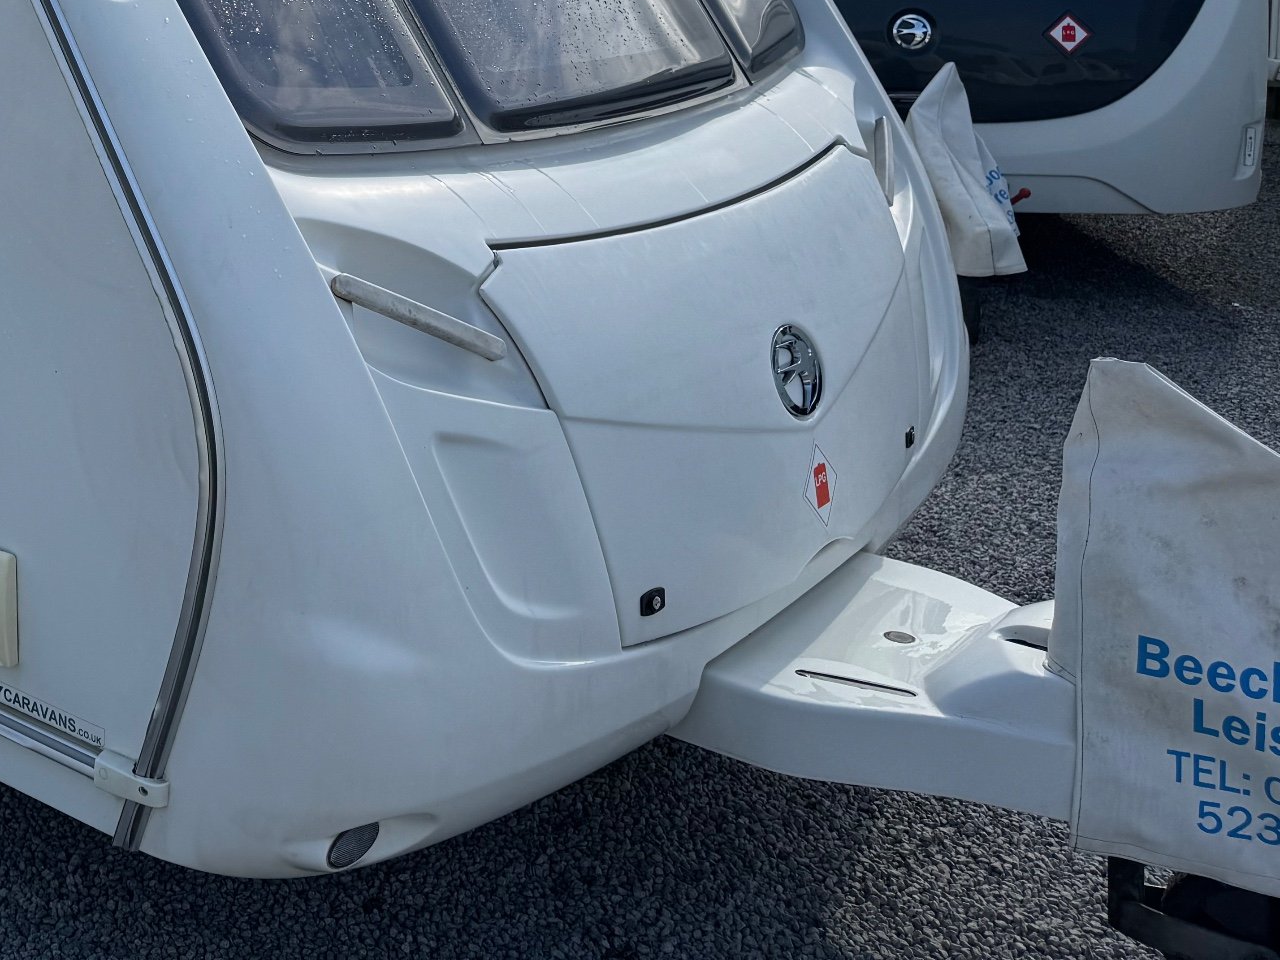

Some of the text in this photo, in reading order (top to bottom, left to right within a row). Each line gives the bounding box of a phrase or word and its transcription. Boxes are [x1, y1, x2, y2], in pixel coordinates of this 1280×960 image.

[815, 471, 827, 487] LPG
[1166, 749, 1251, 796] TEL:
[1196, 800, 1280, 846] 523
